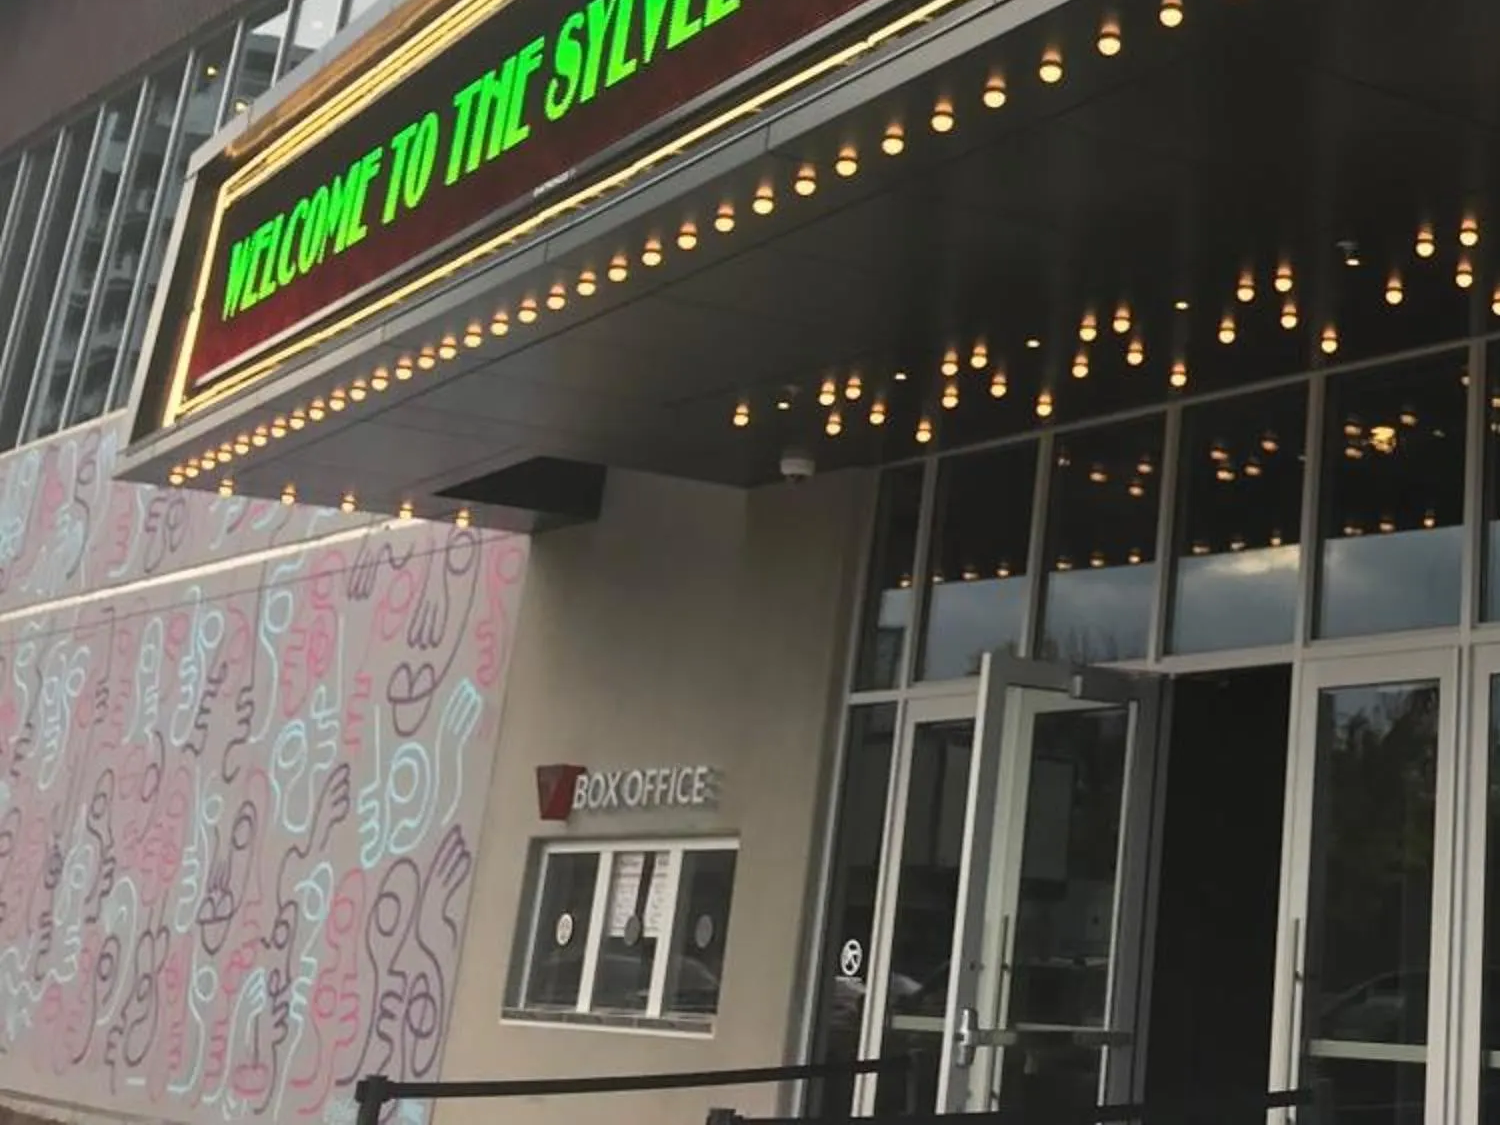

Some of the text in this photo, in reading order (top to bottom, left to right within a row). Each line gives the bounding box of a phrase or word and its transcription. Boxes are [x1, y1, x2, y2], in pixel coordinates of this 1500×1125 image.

[221, 145, 383, 322] WELCOME
[381, 110, 440, 226] TO
[443, 35, 545, 187] THE
[572, 764, 708, 810] BOX OFFICE
